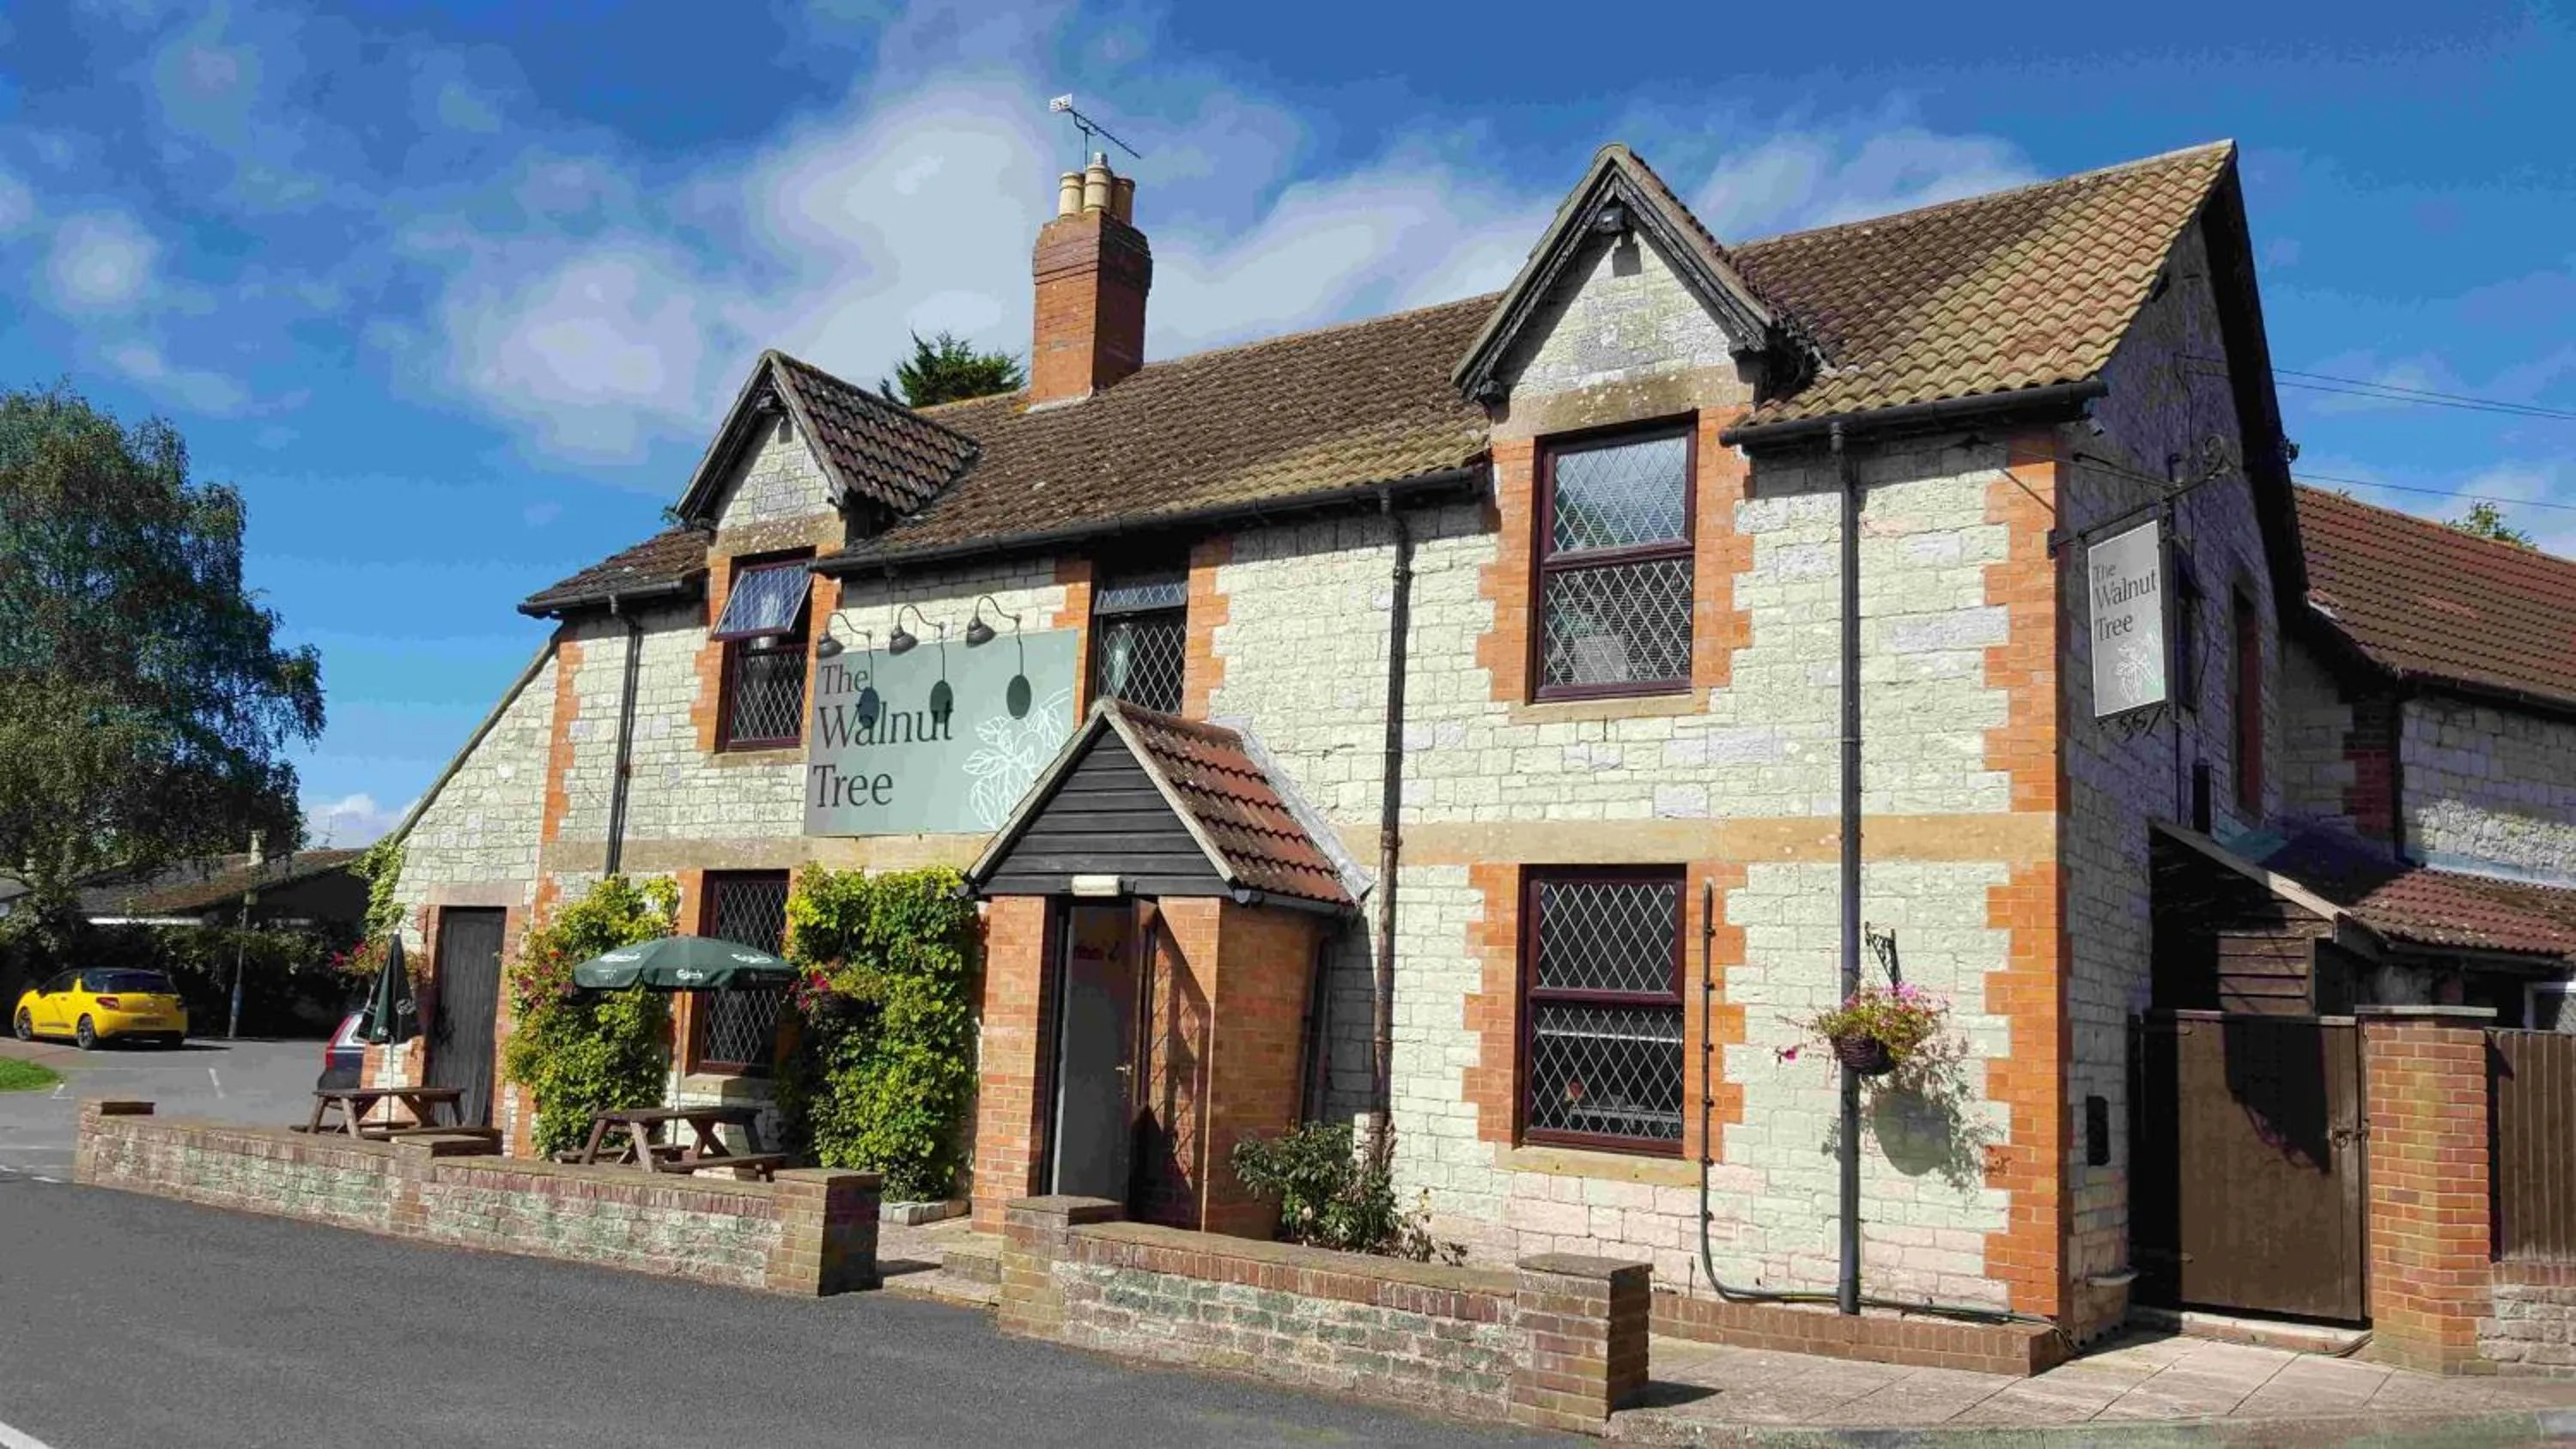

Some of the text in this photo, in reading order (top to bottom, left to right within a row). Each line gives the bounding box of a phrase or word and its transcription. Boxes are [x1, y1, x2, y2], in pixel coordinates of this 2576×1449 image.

[2095, 562, 2117, 582] The
[2096, 569, 2157, 609] Walnut
[2097, 614, 2134, 641] Tree
[822, 664, 869, 694] The
[819, 700, 954, 749] Walnut
[813, 764, 893, 808] Tree
